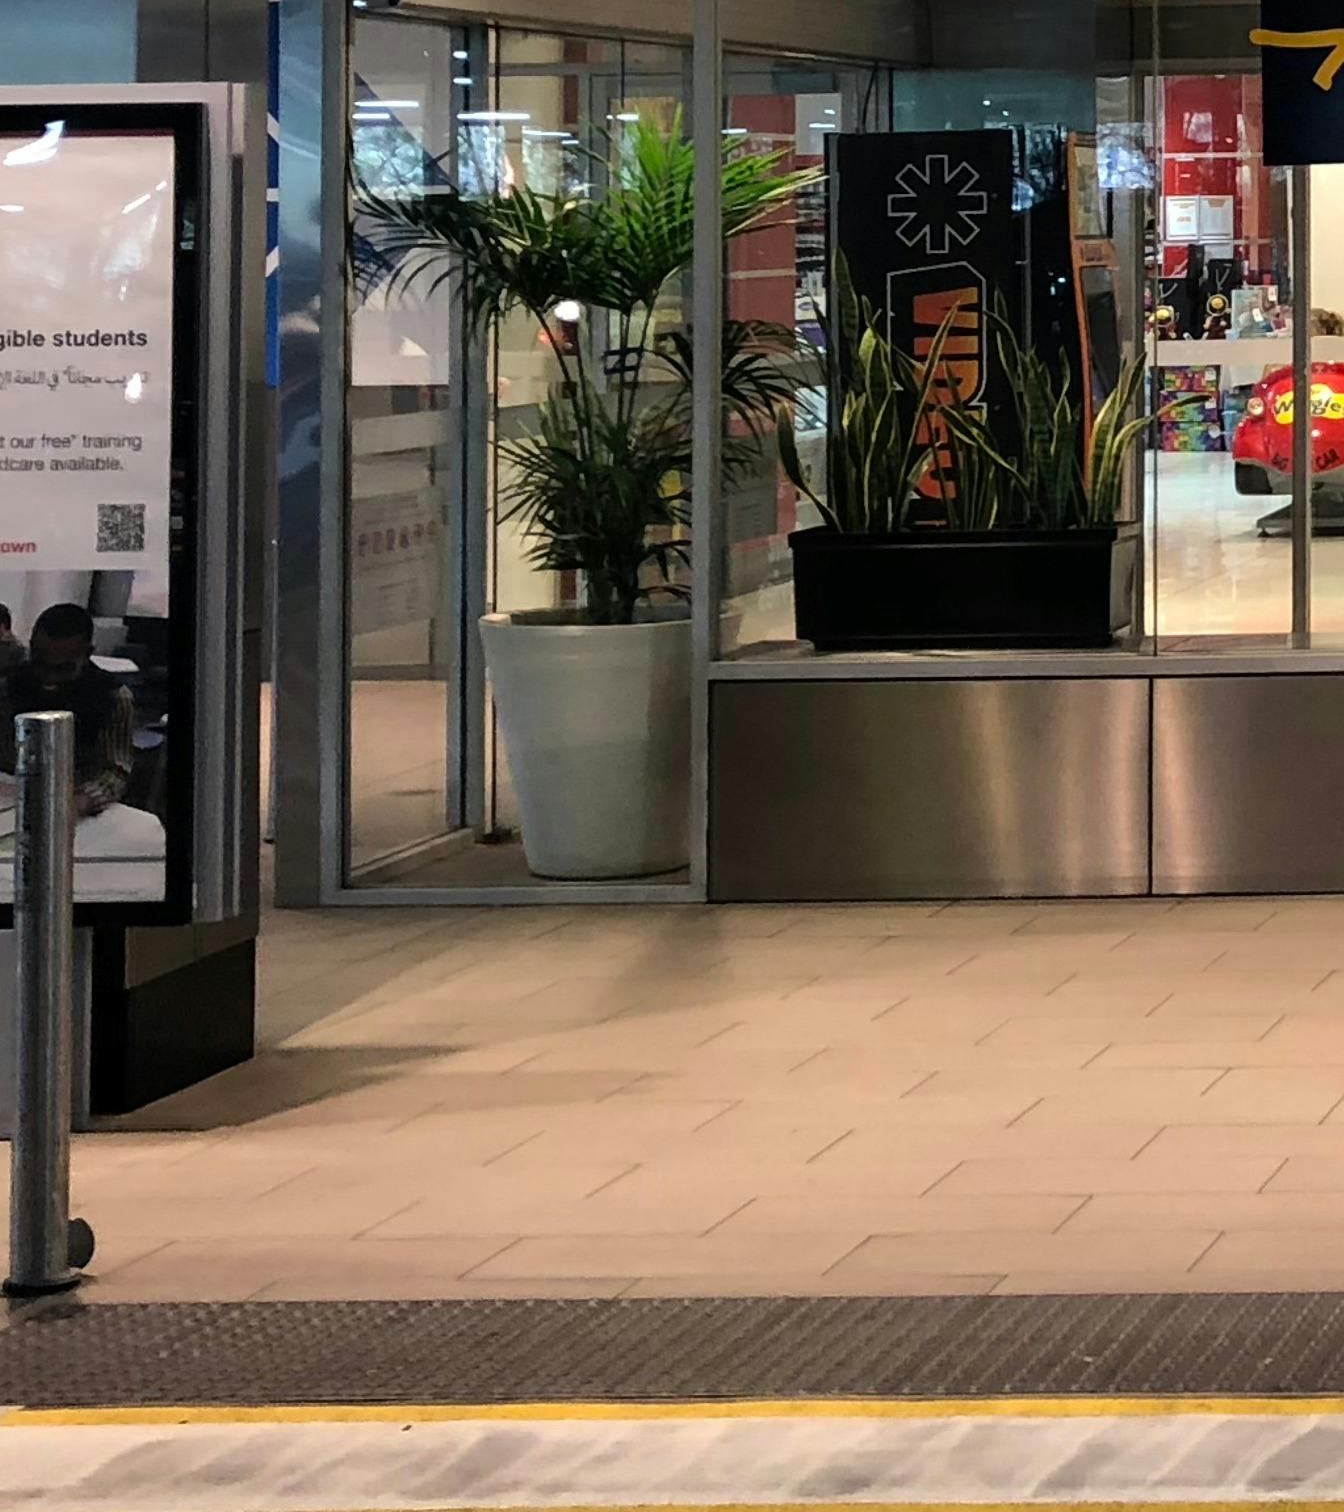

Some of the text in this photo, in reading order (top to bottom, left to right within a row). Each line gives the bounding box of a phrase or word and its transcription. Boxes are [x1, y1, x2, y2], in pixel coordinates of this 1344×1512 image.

[52, 329, 148, 347] students
[10, 436, 35, 449] our
[83, 435, 142, 451] training
[50, 456, 124, 471] available.
